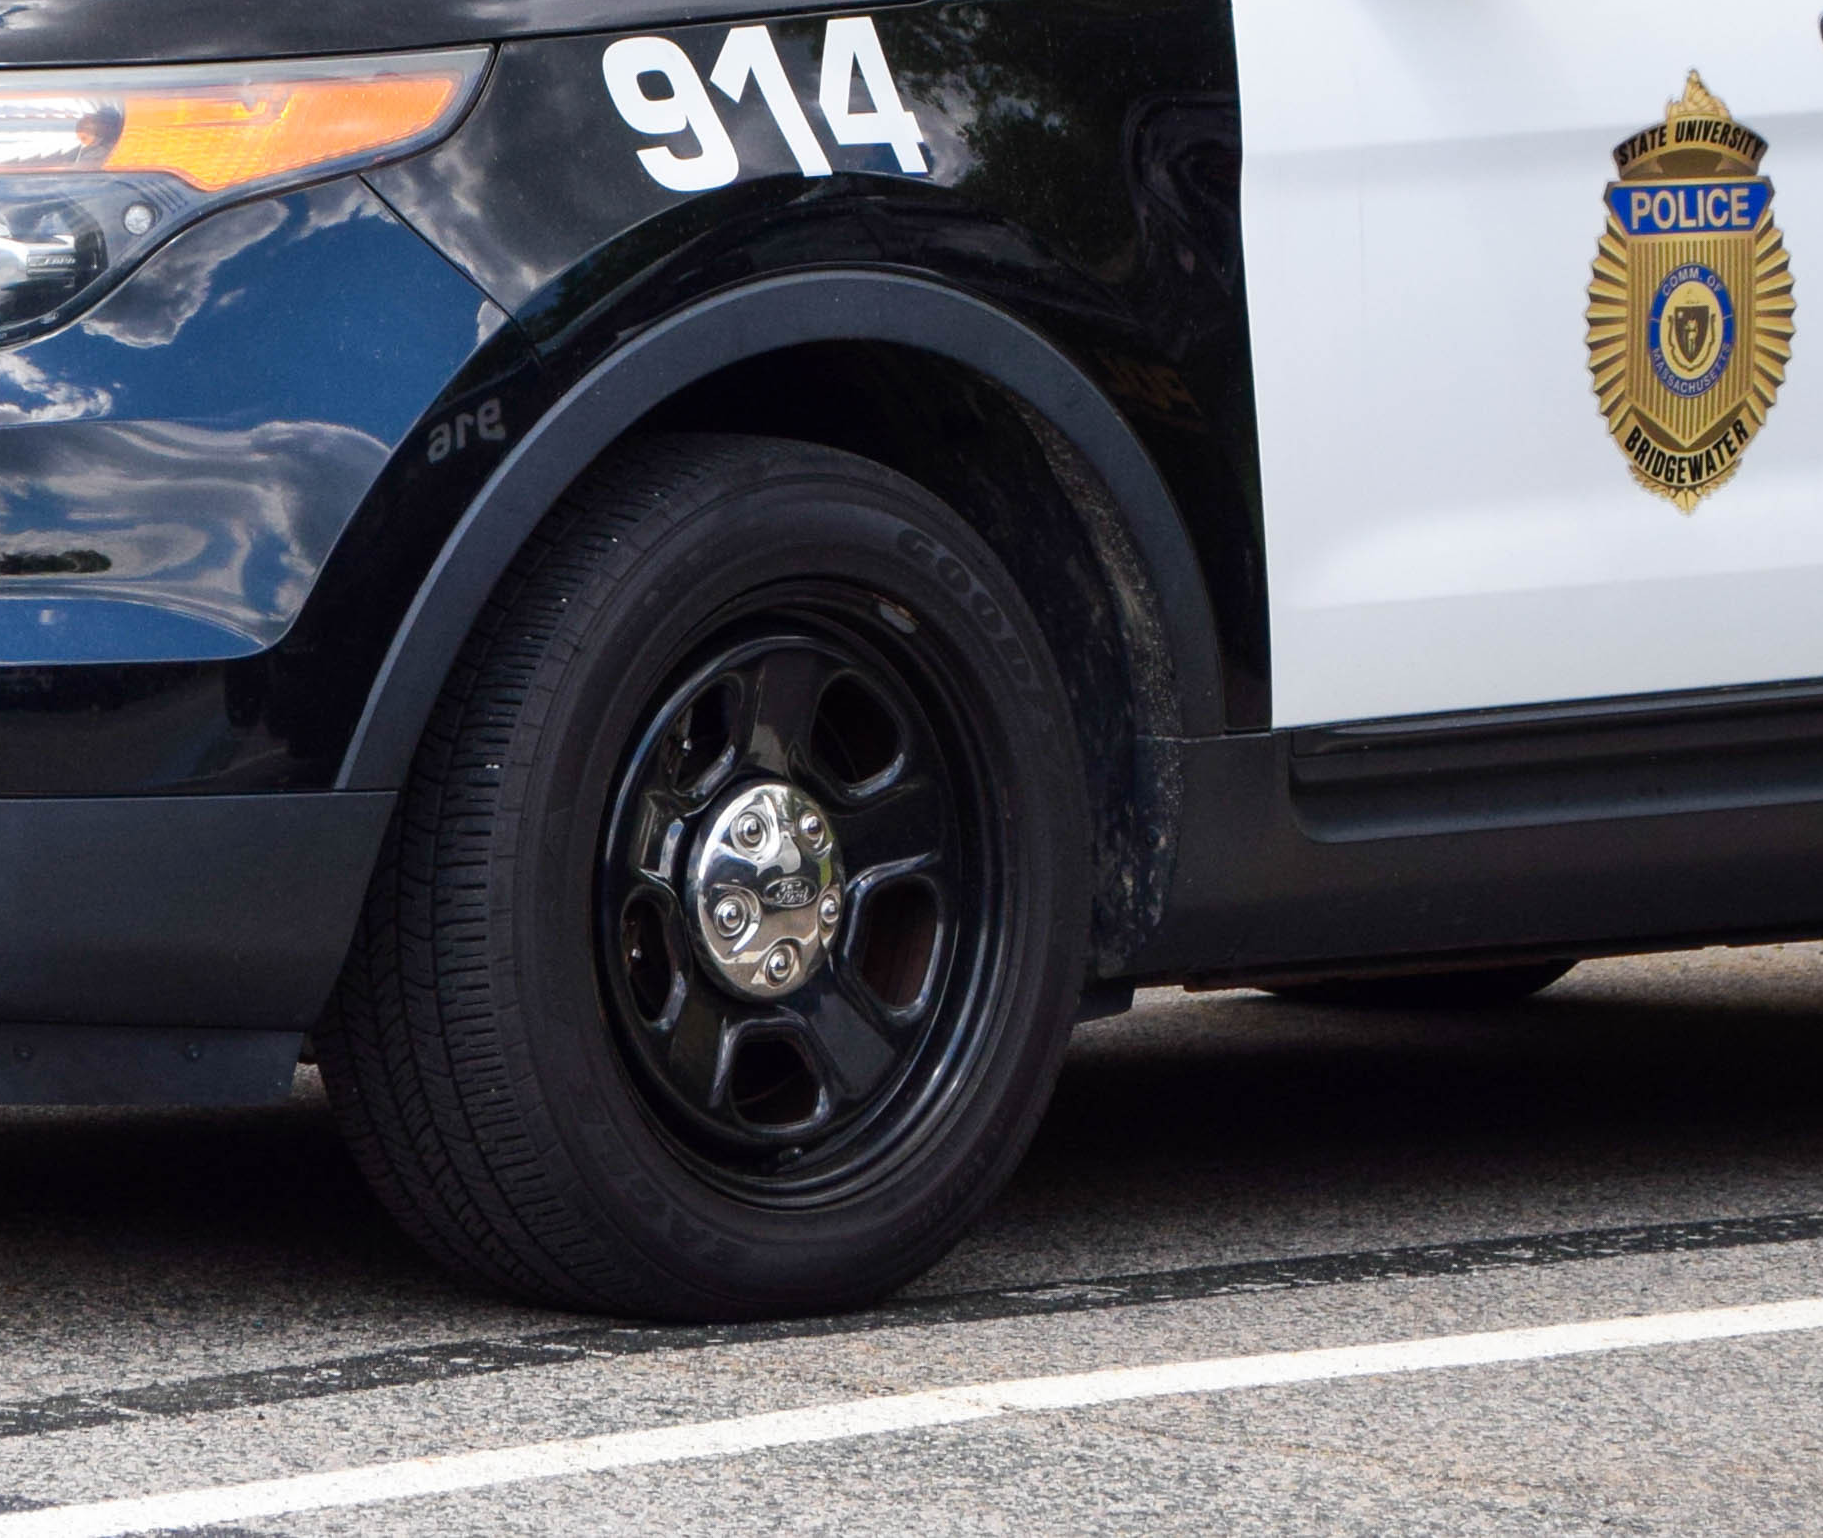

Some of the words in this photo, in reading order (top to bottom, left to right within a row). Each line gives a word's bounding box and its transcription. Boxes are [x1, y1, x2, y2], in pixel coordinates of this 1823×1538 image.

[601, 16, 928, 192] 914
[1618, 125, 1667, 166] STATE
[1675, 119, 1765, 161] UNIVERSITY
[1631, 188, 1750, 230] POLICE
[1624, 419, 1749, 483] BRIDGEWATER
